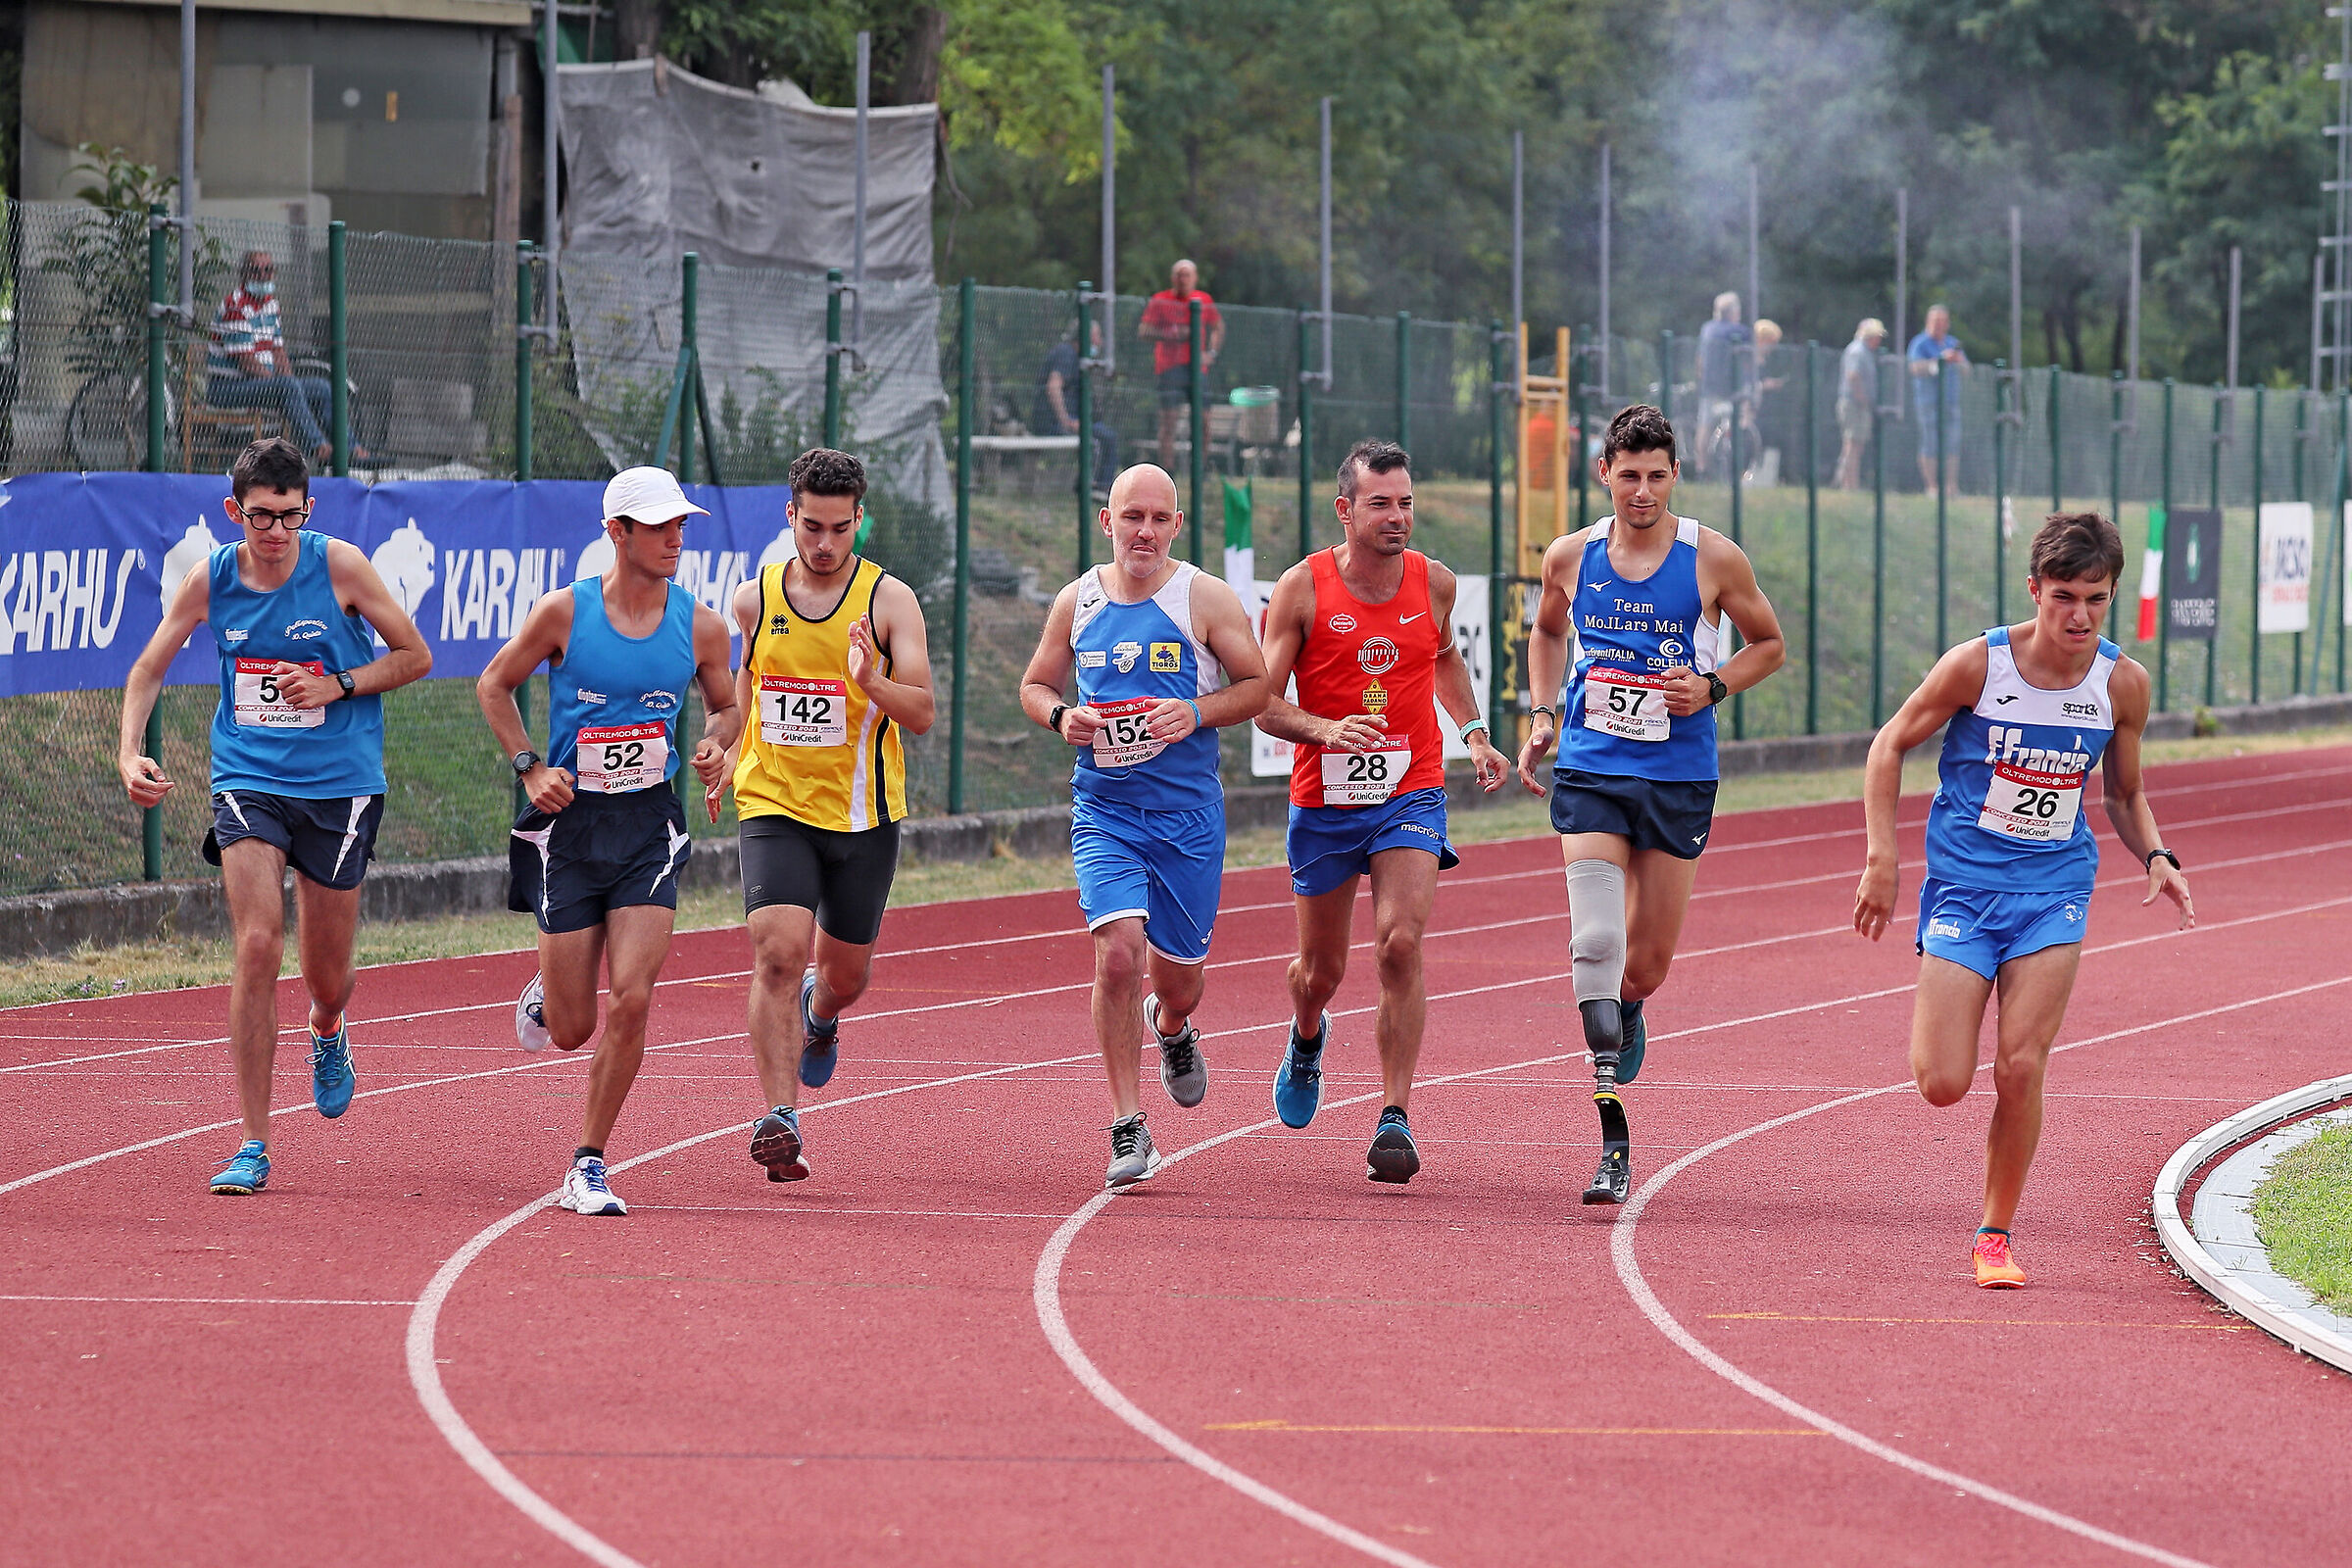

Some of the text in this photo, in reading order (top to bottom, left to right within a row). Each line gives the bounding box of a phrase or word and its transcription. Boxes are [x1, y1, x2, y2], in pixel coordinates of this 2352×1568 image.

[1613, 598, 1654, 613] Team
[1654, 619, 1685, 633] Mai
[1646, 657, 1692, 668] COLELLA
[260, 676, 286, 703] 5
[775, 694, 832, 724] 142
[1608, 686, 1648, 716] 57
[268, 711, 302, 723] UniCredit
[1100, 714, 1152, 747] 152
[1613, 721, 1645, 736] UniCredit
[789, 733, 822, 743] UniCredit
[603, 742, 645, 770] 52
[1121, 750, 1154, 762] UniCredit
[1347, 754, 1388, 781] 28
[612, 776, 644, 789] UniCredit
[2001, 767, 2079, 785] OLTREMODOLTRE
[2012, 788, 2060, 819] 26
[1400, 823, 1440, 840] macron
[2015, 825, 2050, 837] UniCredit
